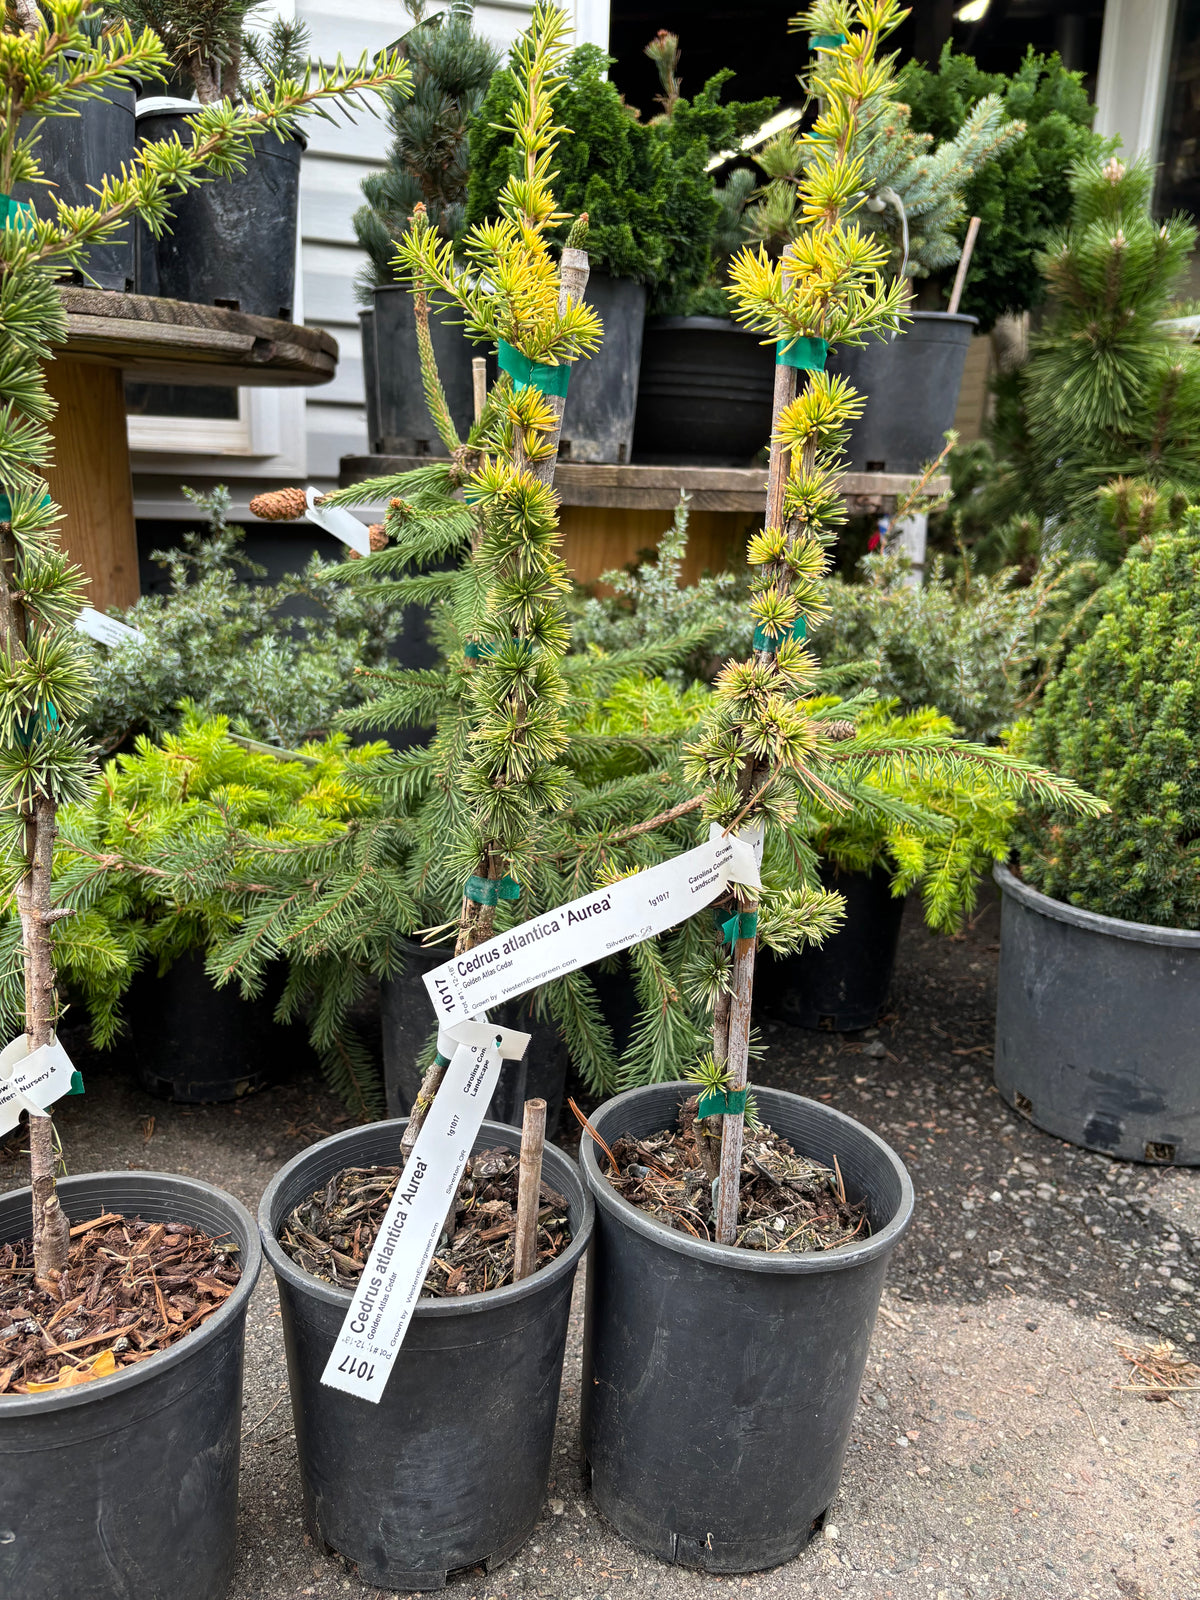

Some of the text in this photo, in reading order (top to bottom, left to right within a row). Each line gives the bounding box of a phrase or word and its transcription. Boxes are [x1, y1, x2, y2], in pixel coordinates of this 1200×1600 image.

[688, 867, 713, 884] Carolina
[712, 854, 734, 870] Conifers
[690, 872, 720, 893] Landscape
[457, 893, 612, 977] Cedrus atlantica 'Aurea'
[462, 959, 514, 989] Golden Atlas Cedar
[472, 998, 490, 1010] Grown
[490, 994, 498, 1003] by
[502, 958, 577, 995] WesternEvergreen.com
[605, 932, 640, 950] Silverton,
[434, 978, 456, 1013] 1017
[14, 1074, 26, 1084] for
[19, 1071, 49, 1093] Nursery
[464, 1062, 480, 1094] Carolina
[470, 1059, 490, 1097] Landscape
[350, 1156, 428, 1334] Cedrus atlantica 'Aurea'
[390, 1149, 467, 1347] Grown by WesternEvergreen.com Silverton, OR
[367, 1272, 398, 1340] Golden Atlas Cedar
[338, 1354, 376, 1382] 1017
[380, 1348, 392, 1360] Pot
